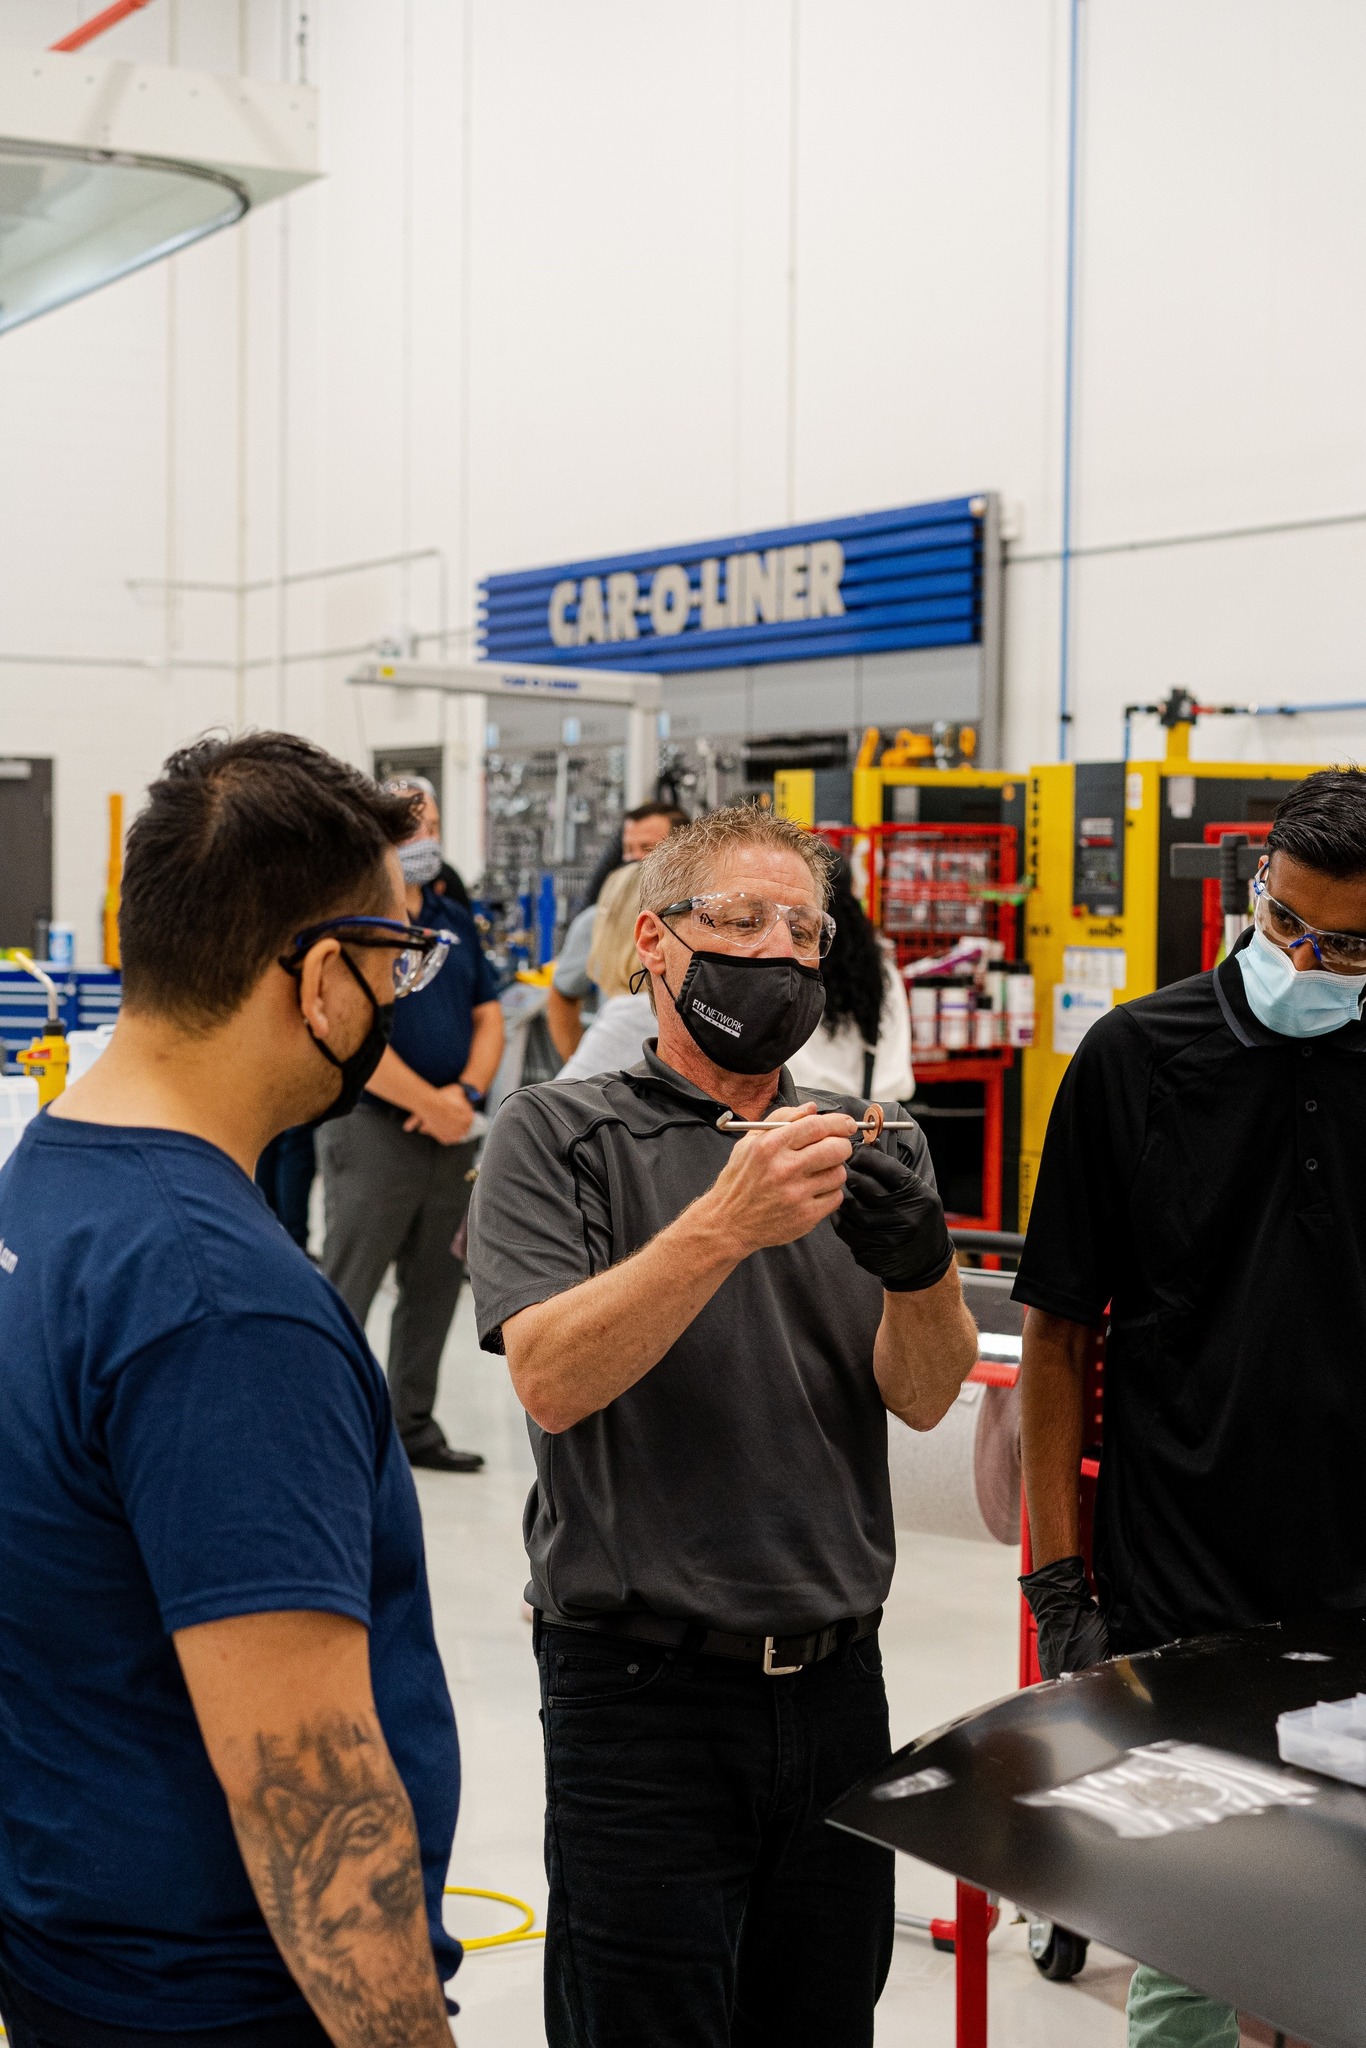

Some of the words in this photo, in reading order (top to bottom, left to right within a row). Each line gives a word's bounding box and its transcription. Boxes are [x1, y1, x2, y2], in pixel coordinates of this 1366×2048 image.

[549, 540, 845, 647] CAR-O-LINER
[692, 998, 707, 1013] FIX
[705, 1006, 744, 1032] NETWORK
